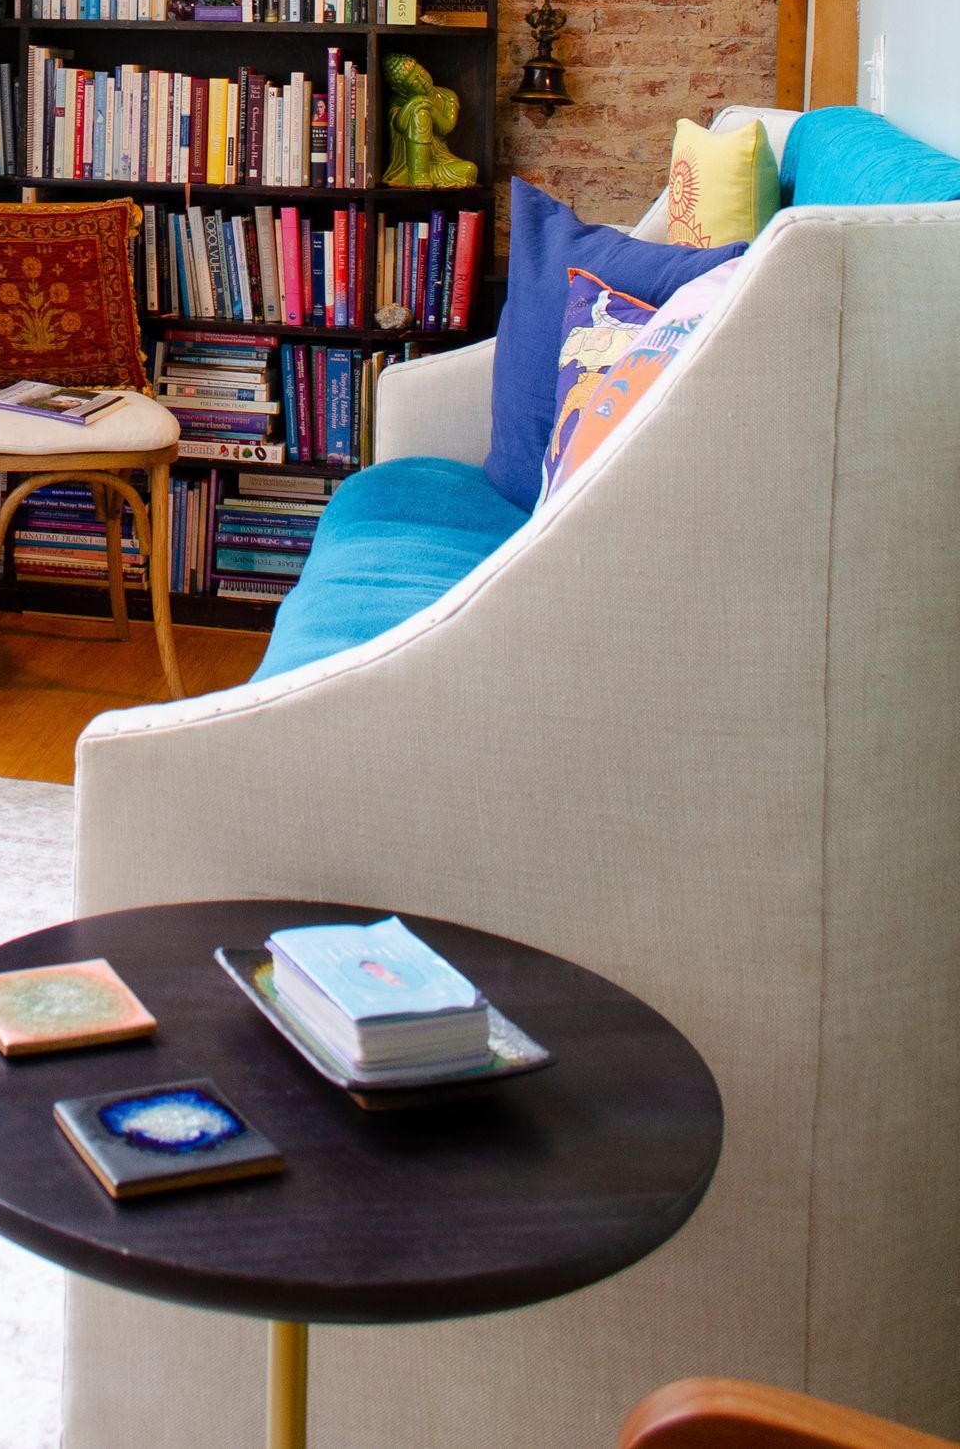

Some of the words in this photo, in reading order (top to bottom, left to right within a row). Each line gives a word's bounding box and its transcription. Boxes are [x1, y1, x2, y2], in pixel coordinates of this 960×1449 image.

[426, 4, 487, 12] CONSCIENCE
[76, 74, 84, 92] Wild
[76, 95, 84, 127] Feminine
[250, 151, 259, 166] Heart
[207, 216, 218, 249] POPOL
[338, 218, 346, 251] INFINITE
[210, 250, 221, 272] VUH
[432, 238, 440, 263] Twelve
[338, 254, 346, 270] LIFE
[429, 282, 437, 306] Swans
[454, 273, 468, 311] RUMI
[286, 374, 294, 398] vedge
[339, 372, 348, 399] Staying
[214, 415, 250, 425] restaurant
[339, 400, 348, 427] Healthy
[206, 422, 232, 430] classics
[298, 421, 306, 436] vegan
[22, 533, 59, 542] ANATOMY
[62, 535, 88, 543] TRAINS
[273, 528, 292, 536] LIGHT
